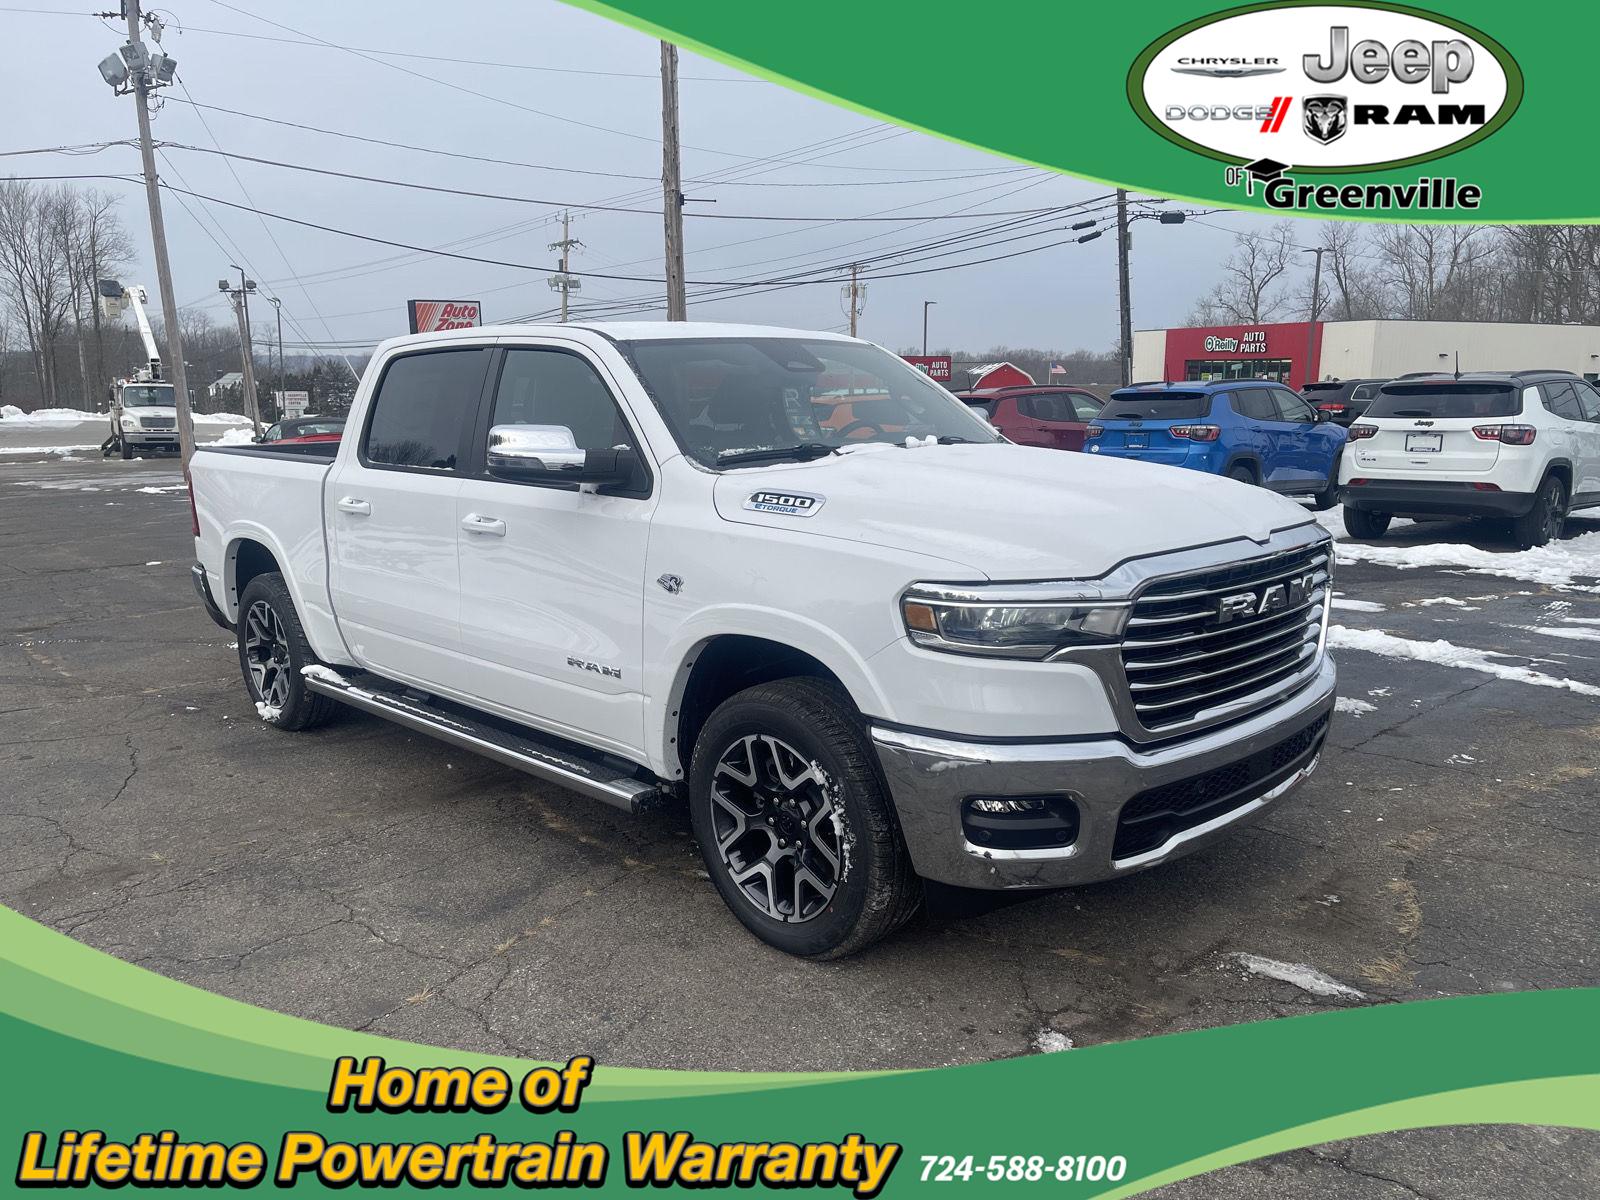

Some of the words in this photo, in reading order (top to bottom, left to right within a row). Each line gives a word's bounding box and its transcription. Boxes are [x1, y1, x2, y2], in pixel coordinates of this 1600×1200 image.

[441, 303, 478, 319] Auto
[1243, 331, 1265, 342] AUTO
[1205, 336, 1238, 353] O'Reilly
[1240, 343, 1267, 353] PARTS
[931, 361, 948, 369] AUTO
[929, 369, 949, 377] PARTS
[757, 493, 812, 508] 1500
[1219, 574, 1314, 624] RAM
[567, 656, 622, 679] RAM
